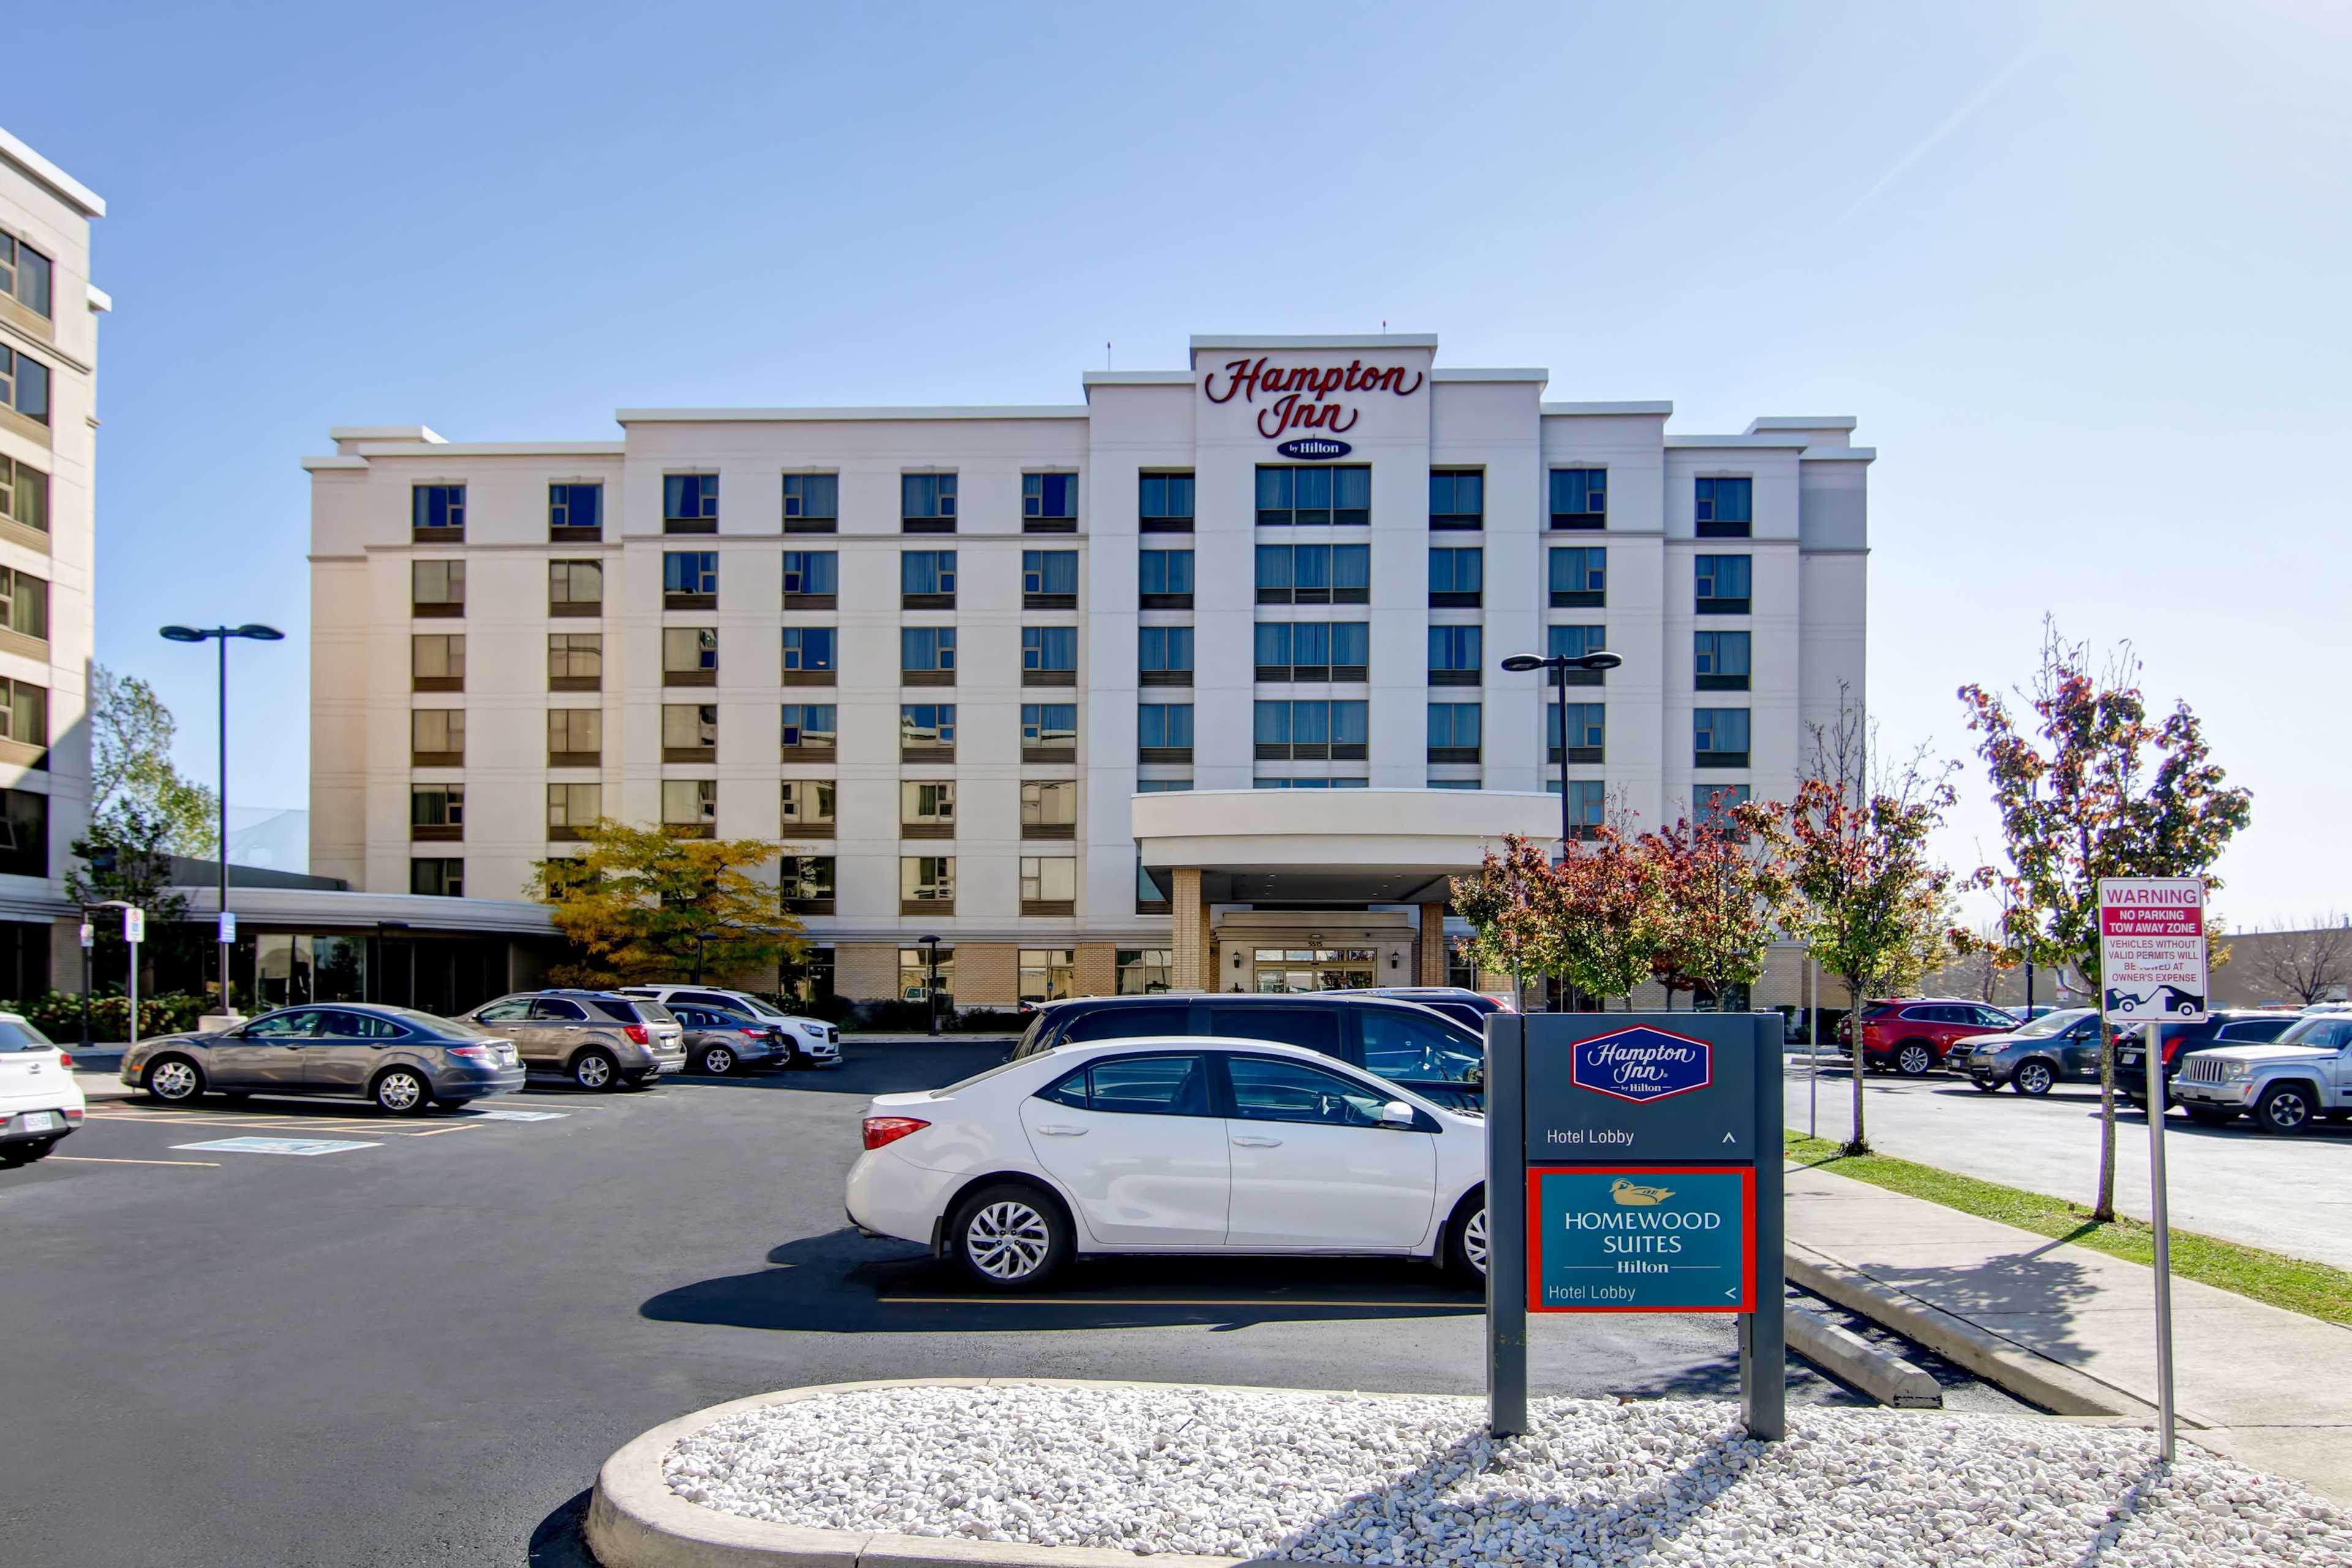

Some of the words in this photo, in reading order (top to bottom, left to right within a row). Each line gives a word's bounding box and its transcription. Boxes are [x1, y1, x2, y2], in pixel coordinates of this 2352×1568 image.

[1205, 357, 1423, 403] Hampton
[1257, 394, 1358, 439] Inn
[1300, 442, 1340, 454] Hilton
[2106, 889, 2196, 904] WARNING
[2119, 910, 2135, 921] NO
[2138, 910, 2185, 920] PARKING
[2109, 923, 2133, 933] TOW
[2135, 923, 2164, 933] AWAY
[2166, 923, 2196, 933] ZONE
[2109, 940, 2154, 948] VEHICLES
[2156, 940, 2196, 948] WITHOUT
[2124, 962, 2136, 971] BE
[2173, 962, 2184, 971] AT
[2112, 973, 2153, 982] OWNER'S
[2155, 973, 2197, 982] EXPENSE
[1588, 1043, 1695, 1066] Hampton
[1613, 1061, 1664, 1083] Inn
[1630, 1084, 1661, 1092] Hilton
[1547, 1129, 1584, 1144] Hotel
[1589, 1129, 1634, 1147] Lobby
[1565, 1212, 1721, 1230] HOMEWOOD
[1603, 1235, 1683, 1254] SUITES
[1617, 1260, 1669, 1273] Hilton
[1549, 1285, 1585, 1299] Hotel
[1591, 1285, 1636, 1302] Lobby
